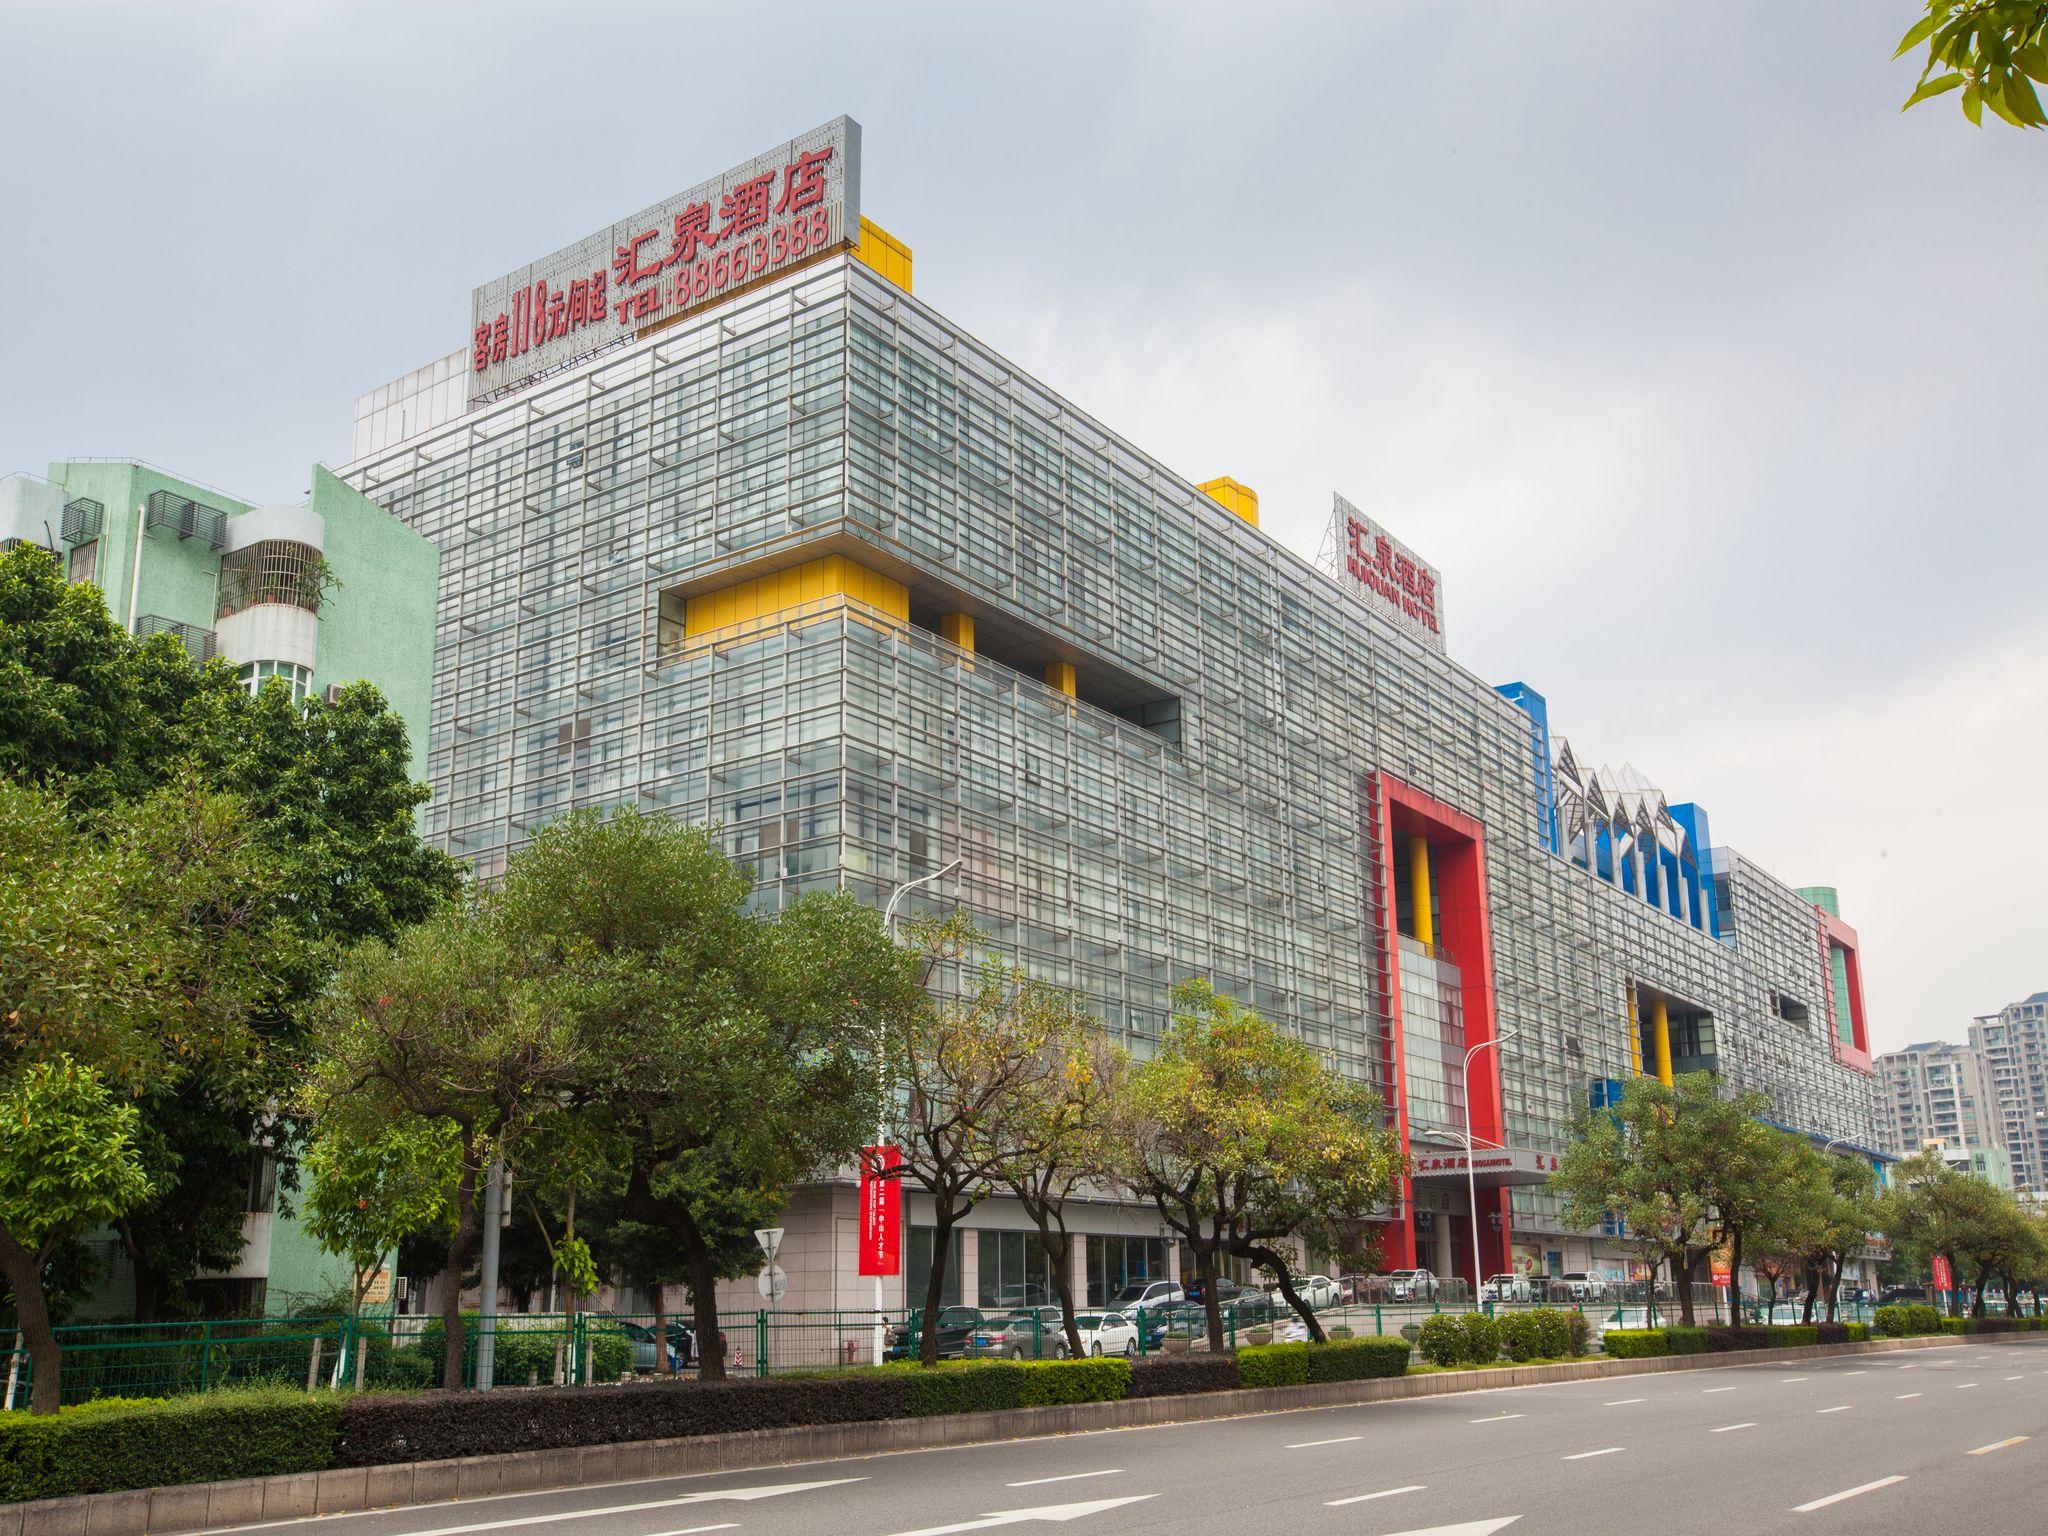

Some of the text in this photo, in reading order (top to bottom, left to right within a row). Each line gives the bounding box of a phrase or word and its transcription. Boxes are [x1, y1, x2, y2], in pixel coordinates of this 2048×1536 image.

[612, 146, 833, 287] 汇泉酒店
[1347, 516, 1435, 610] 汇泉酒店
[1347, 555, 1440, 634] HUIQUAN HOTEL
